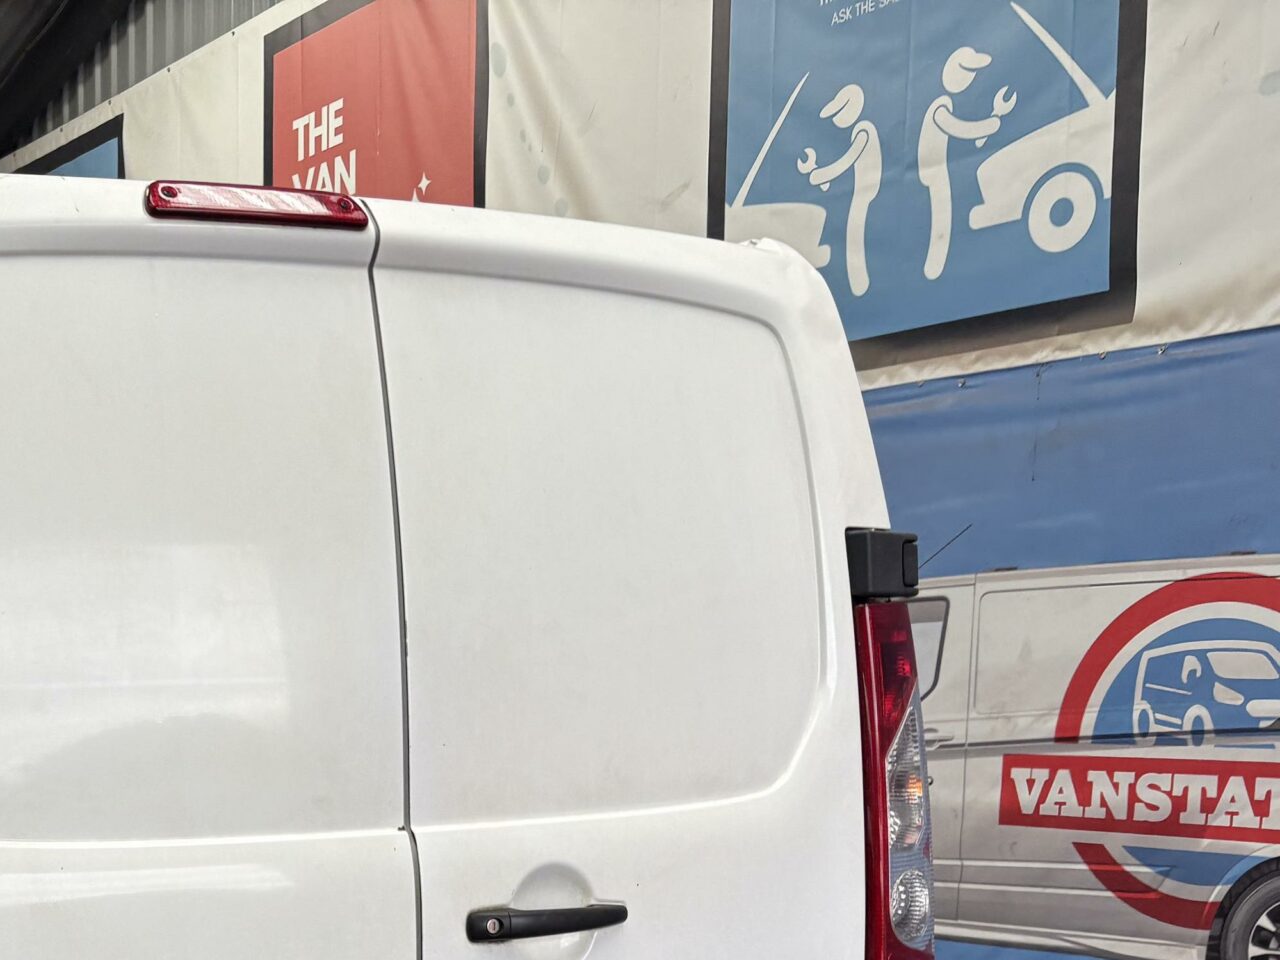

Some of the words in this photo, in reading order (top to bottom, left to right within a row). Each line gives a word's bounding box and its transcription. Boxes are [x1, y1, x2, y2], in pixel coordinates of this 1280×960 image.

[831, 6, 853, 26] ASK
[855, 0, 875, 16] THE
[292, 98, 344, 162] THE
[1010, 767, 1280, 829] VANSTAT
